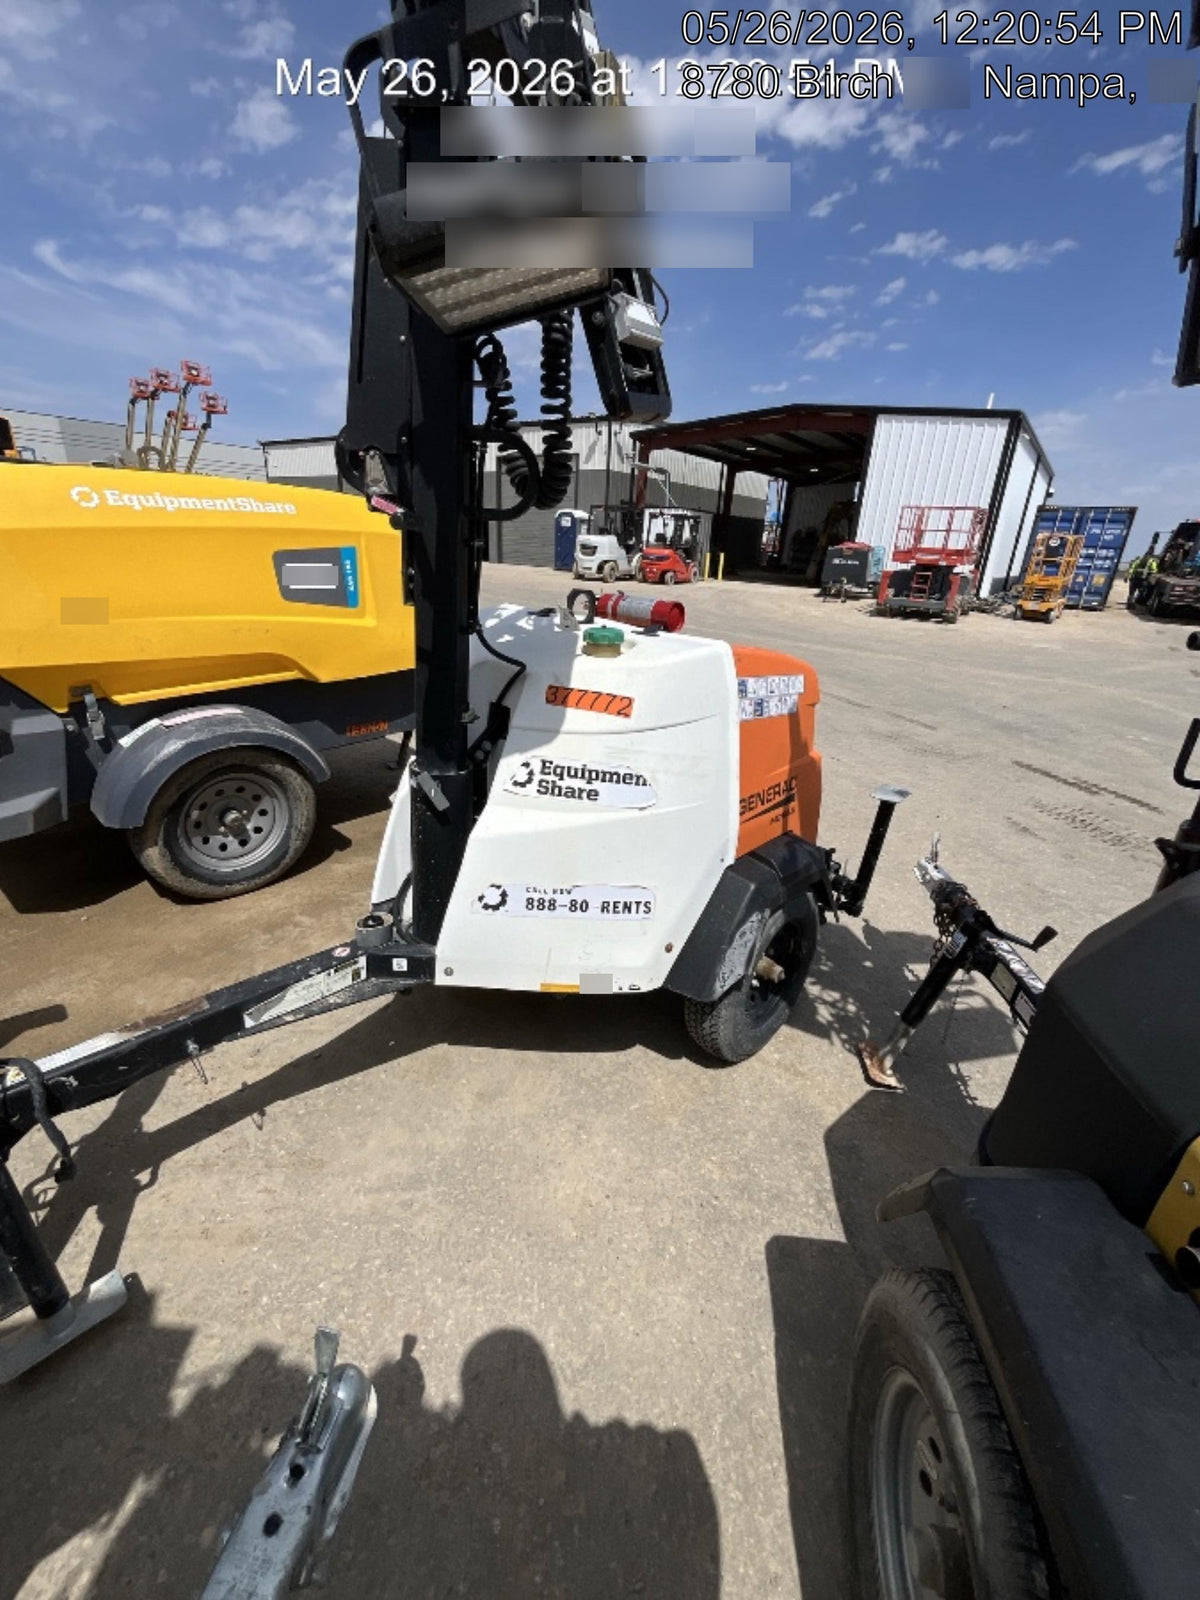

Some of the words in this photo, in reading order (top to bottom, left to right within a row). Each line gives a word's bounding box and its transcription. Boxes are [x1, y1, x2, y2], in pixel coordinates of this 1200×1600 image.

[103, 489, 297, 515] EquipmentShare
[539, 759, 652, 786] Equipmen
[536, 778, 600, 801] Share
